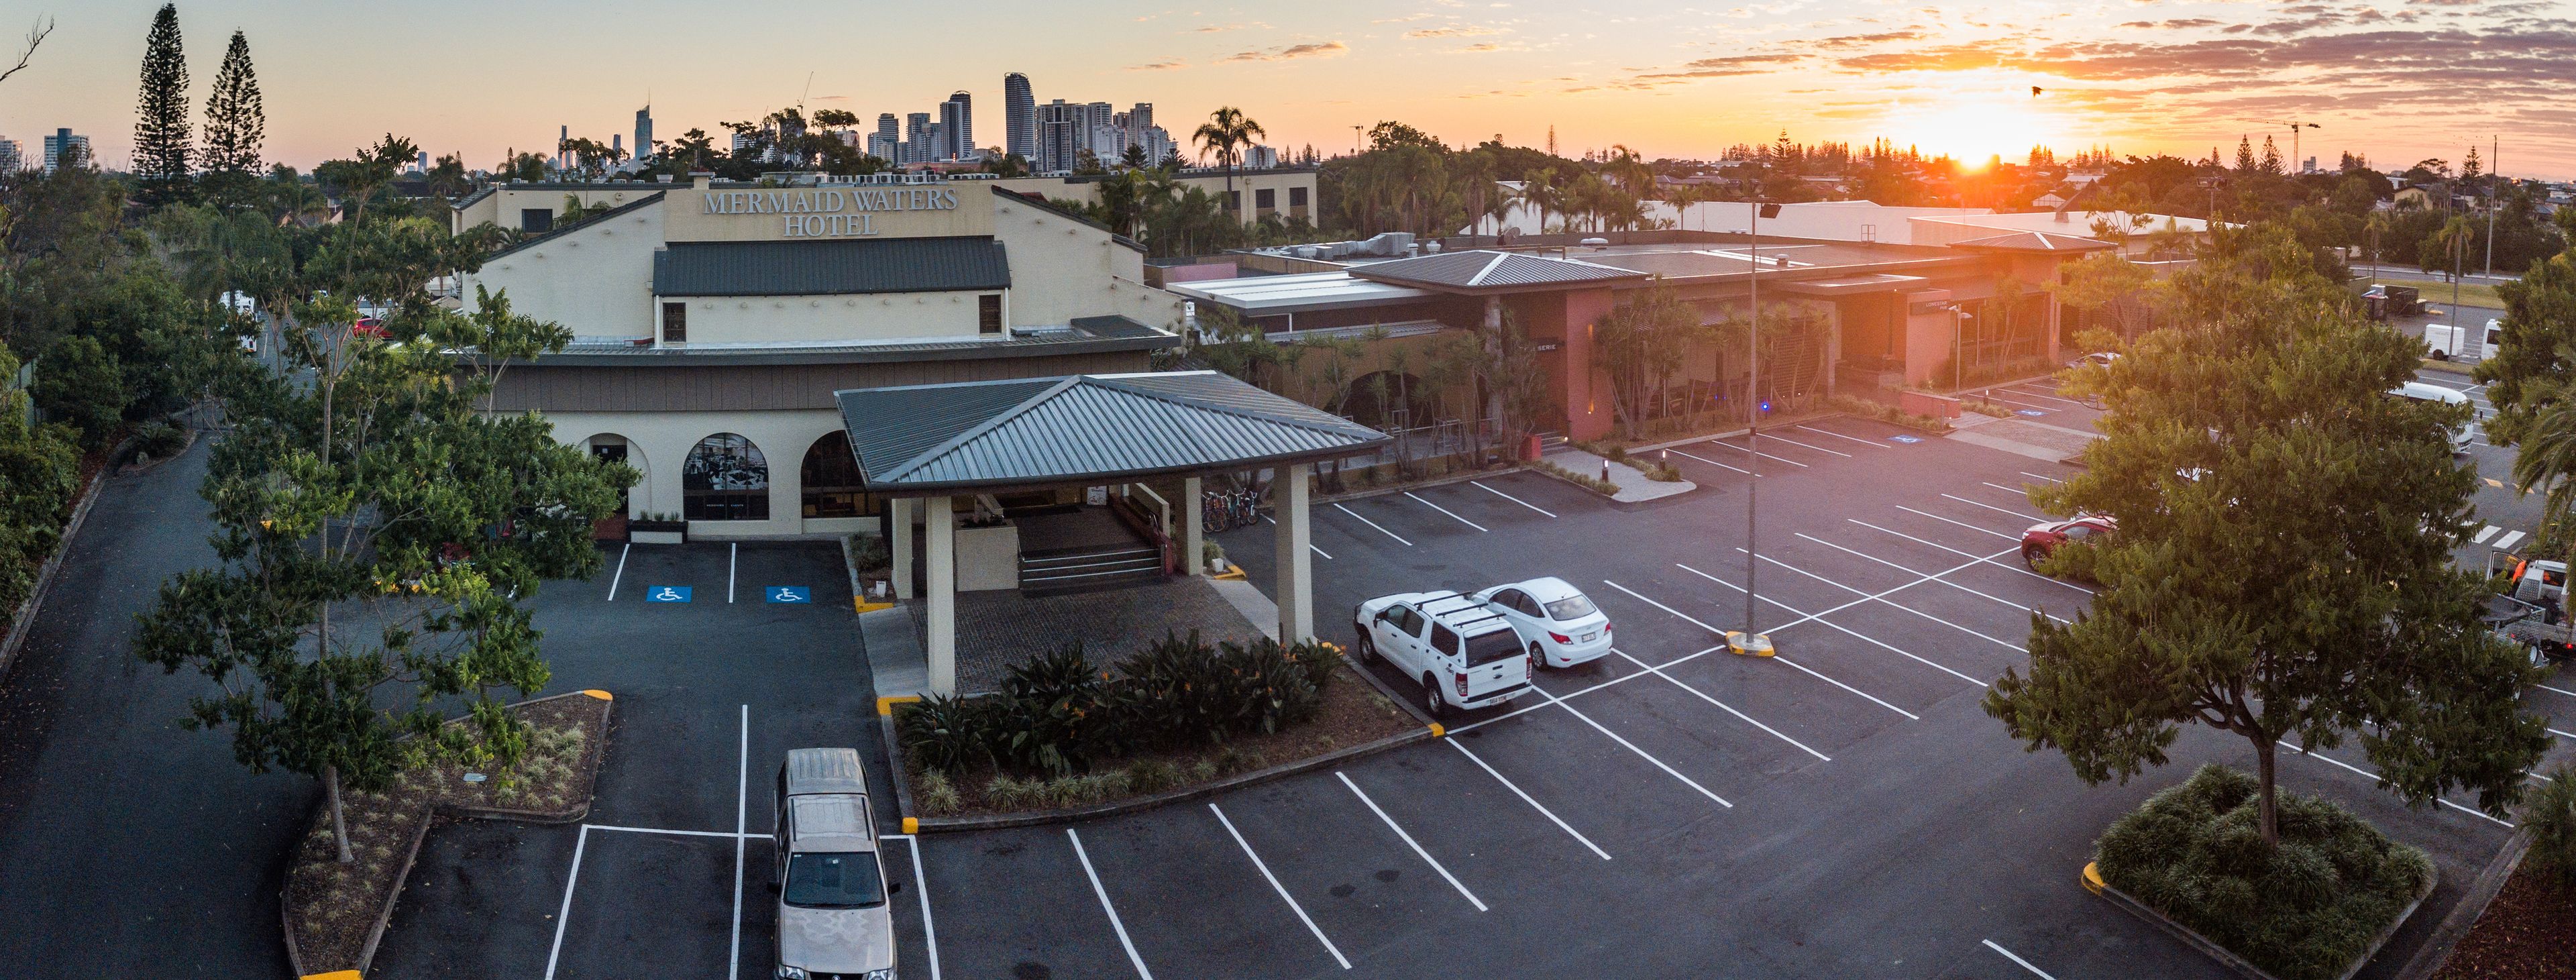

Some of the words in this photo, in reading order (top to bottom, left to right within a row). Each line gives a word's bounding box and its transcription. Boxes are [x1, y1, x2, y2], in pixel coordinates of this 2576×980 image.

[704, 191, 845, 215] MERMAID
[853, 188, 959, 212] WATERS
[784, 214, 879, 237] HOTEL
